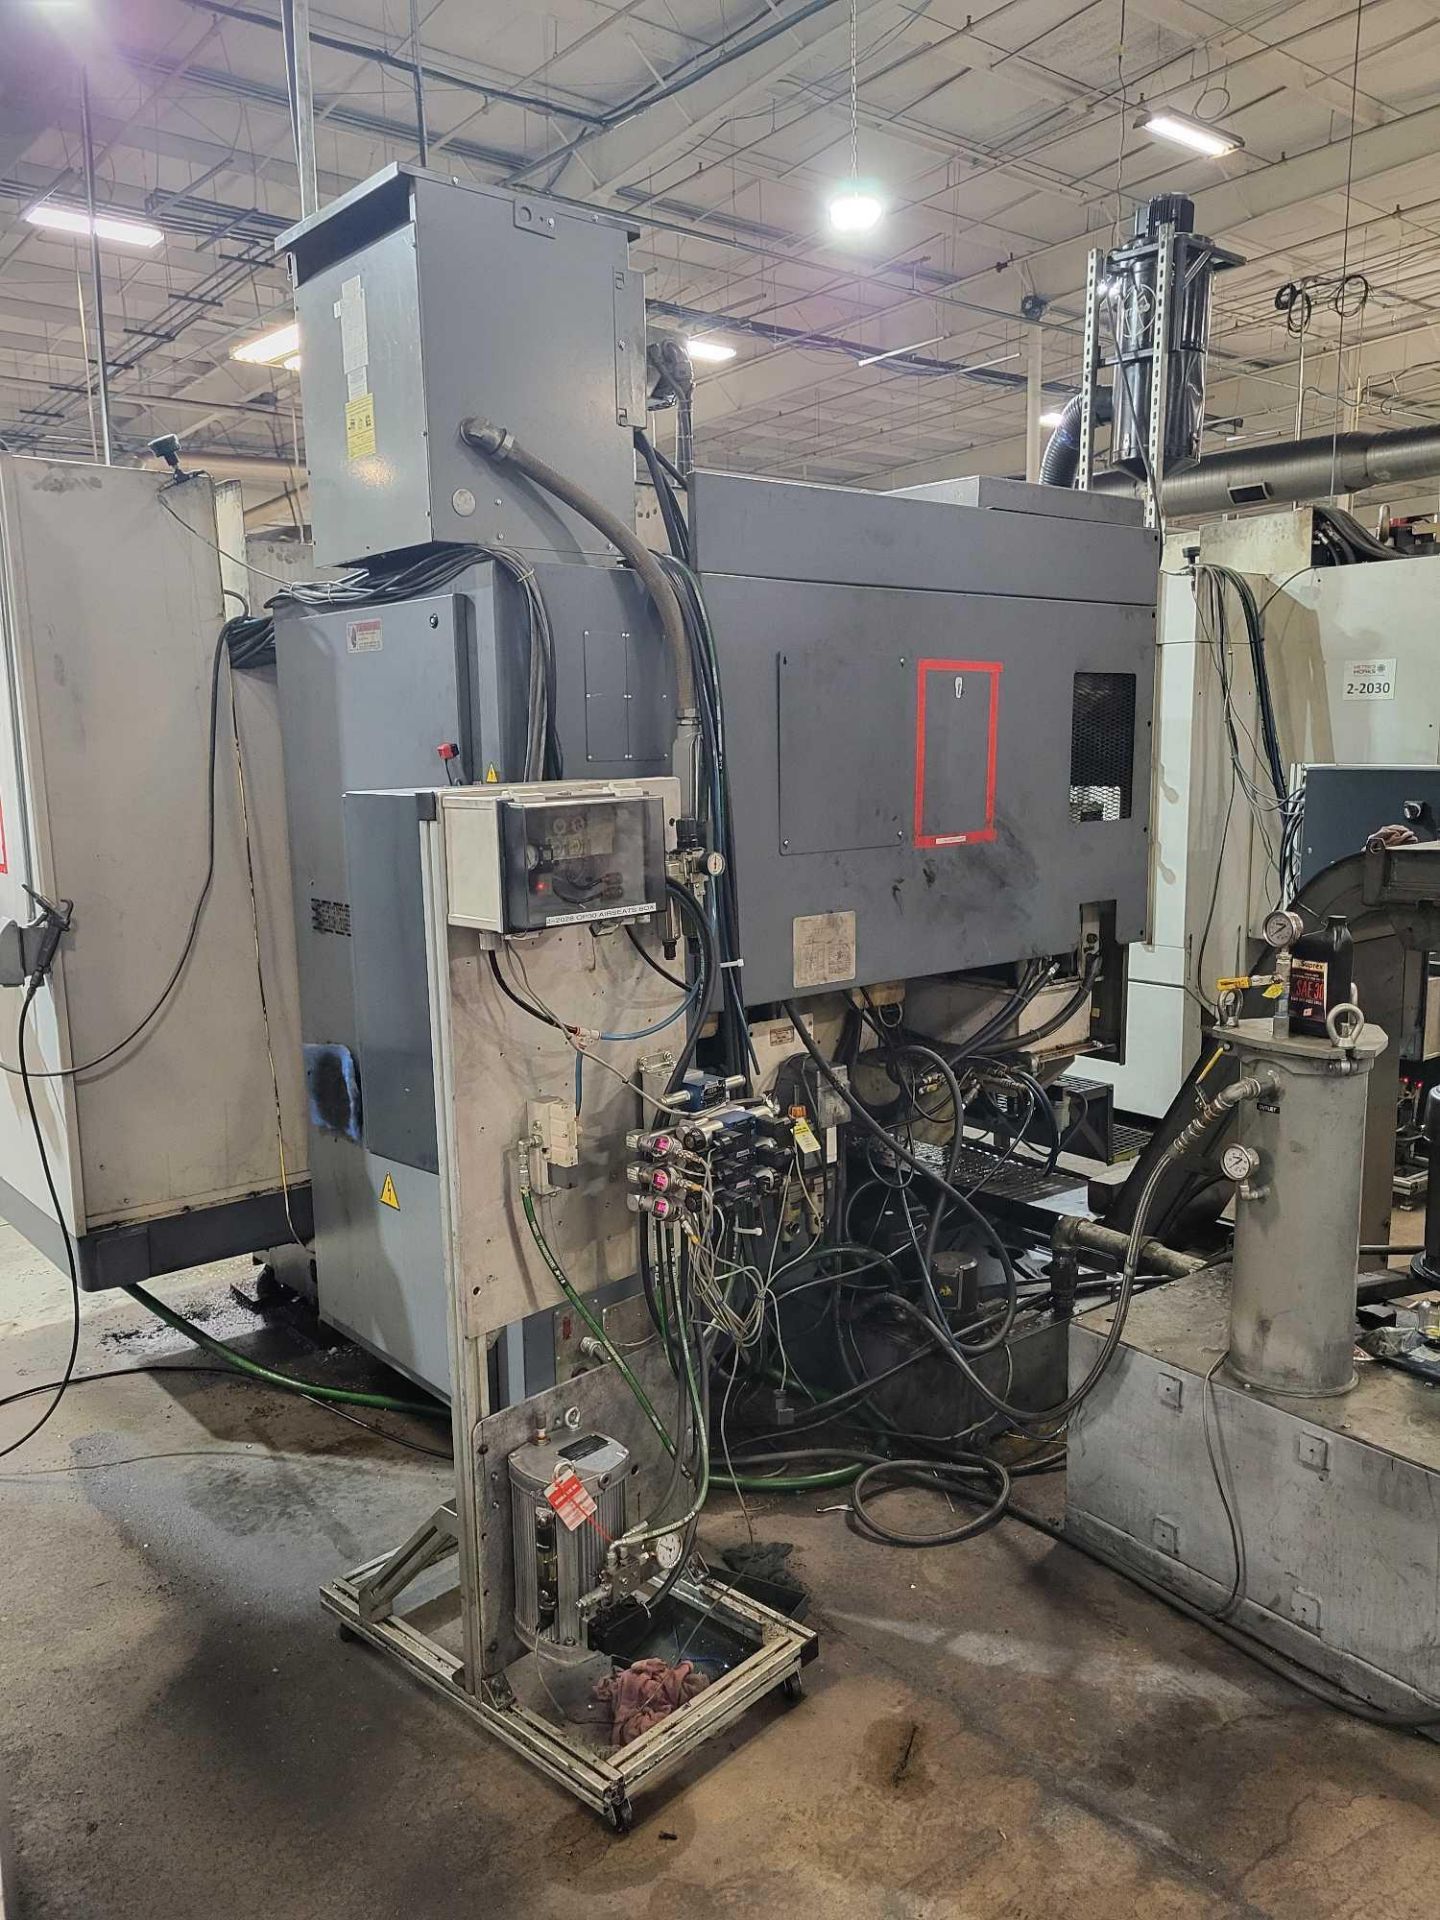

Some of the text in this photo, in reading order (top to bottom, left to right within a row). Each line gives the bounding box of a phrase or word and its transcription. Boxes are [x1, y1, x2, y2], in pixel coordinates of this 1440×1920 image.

[1347, 682, 1390, 695] 2-2030
[1300, 961, 1323, 970] Suprex
[1296, 979, 1324, 1000] SAE 30
